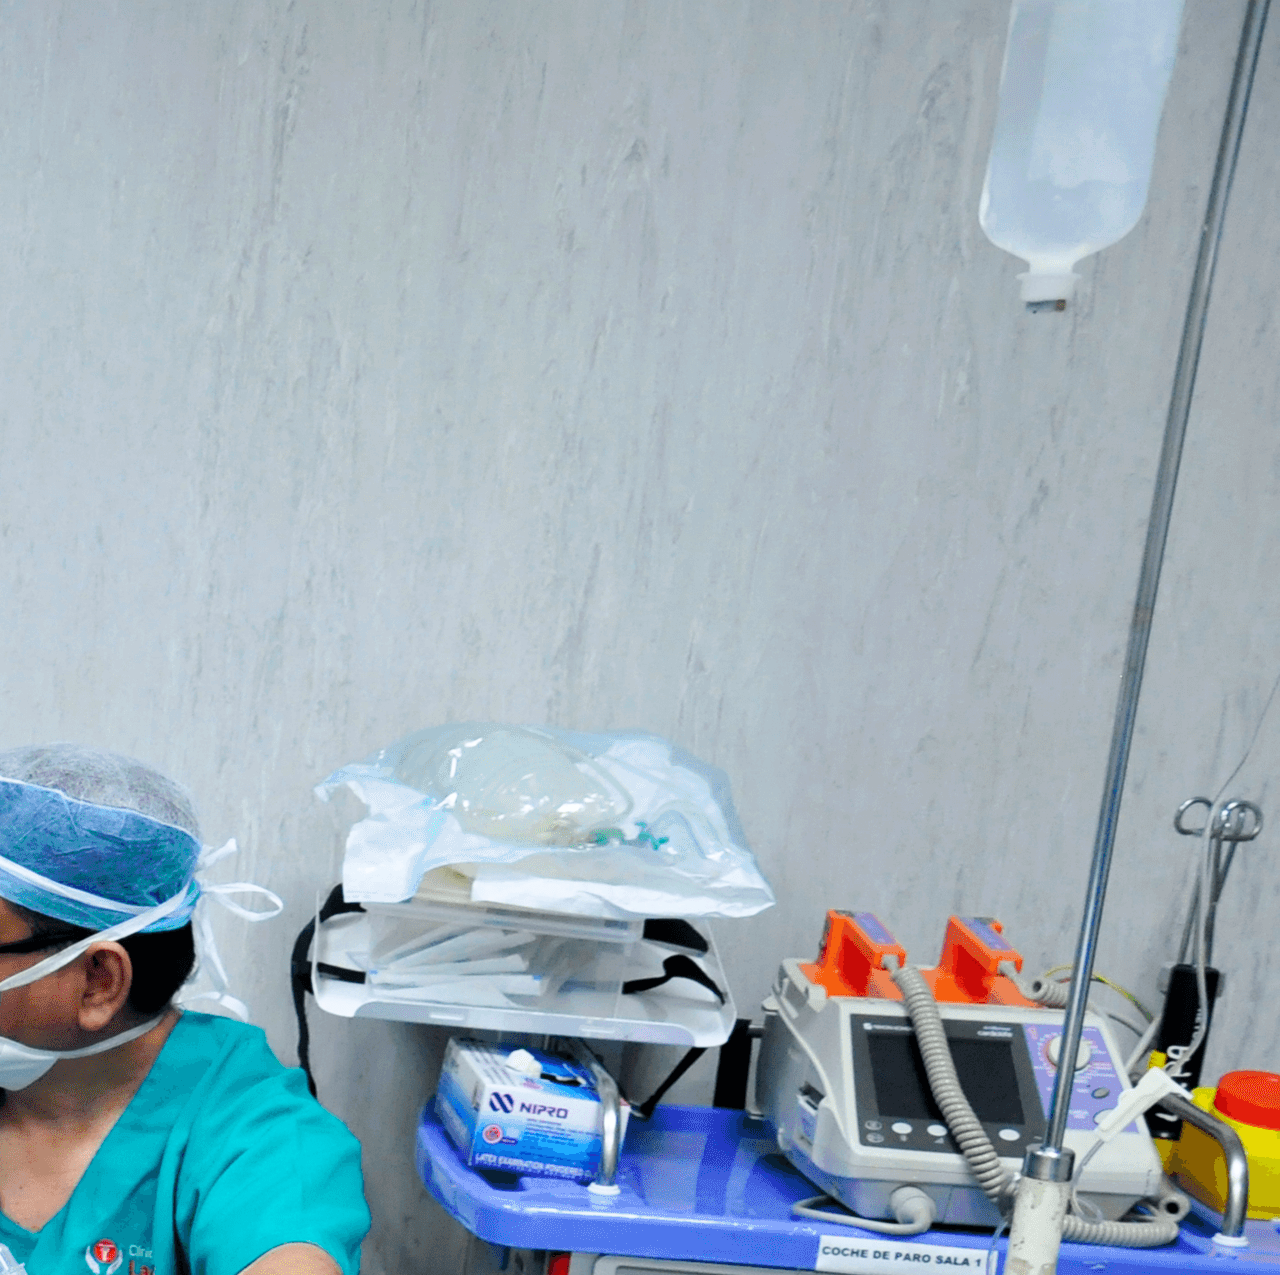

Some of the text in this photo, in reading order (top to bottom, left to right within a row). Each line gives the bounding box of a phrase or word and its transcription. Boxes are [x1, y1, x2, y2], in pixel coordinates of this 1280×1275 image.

[520, 1102, 569, 1119] NIPRO
[822, 1246, 982, 1267] COCHE DE PARO SALA 1
